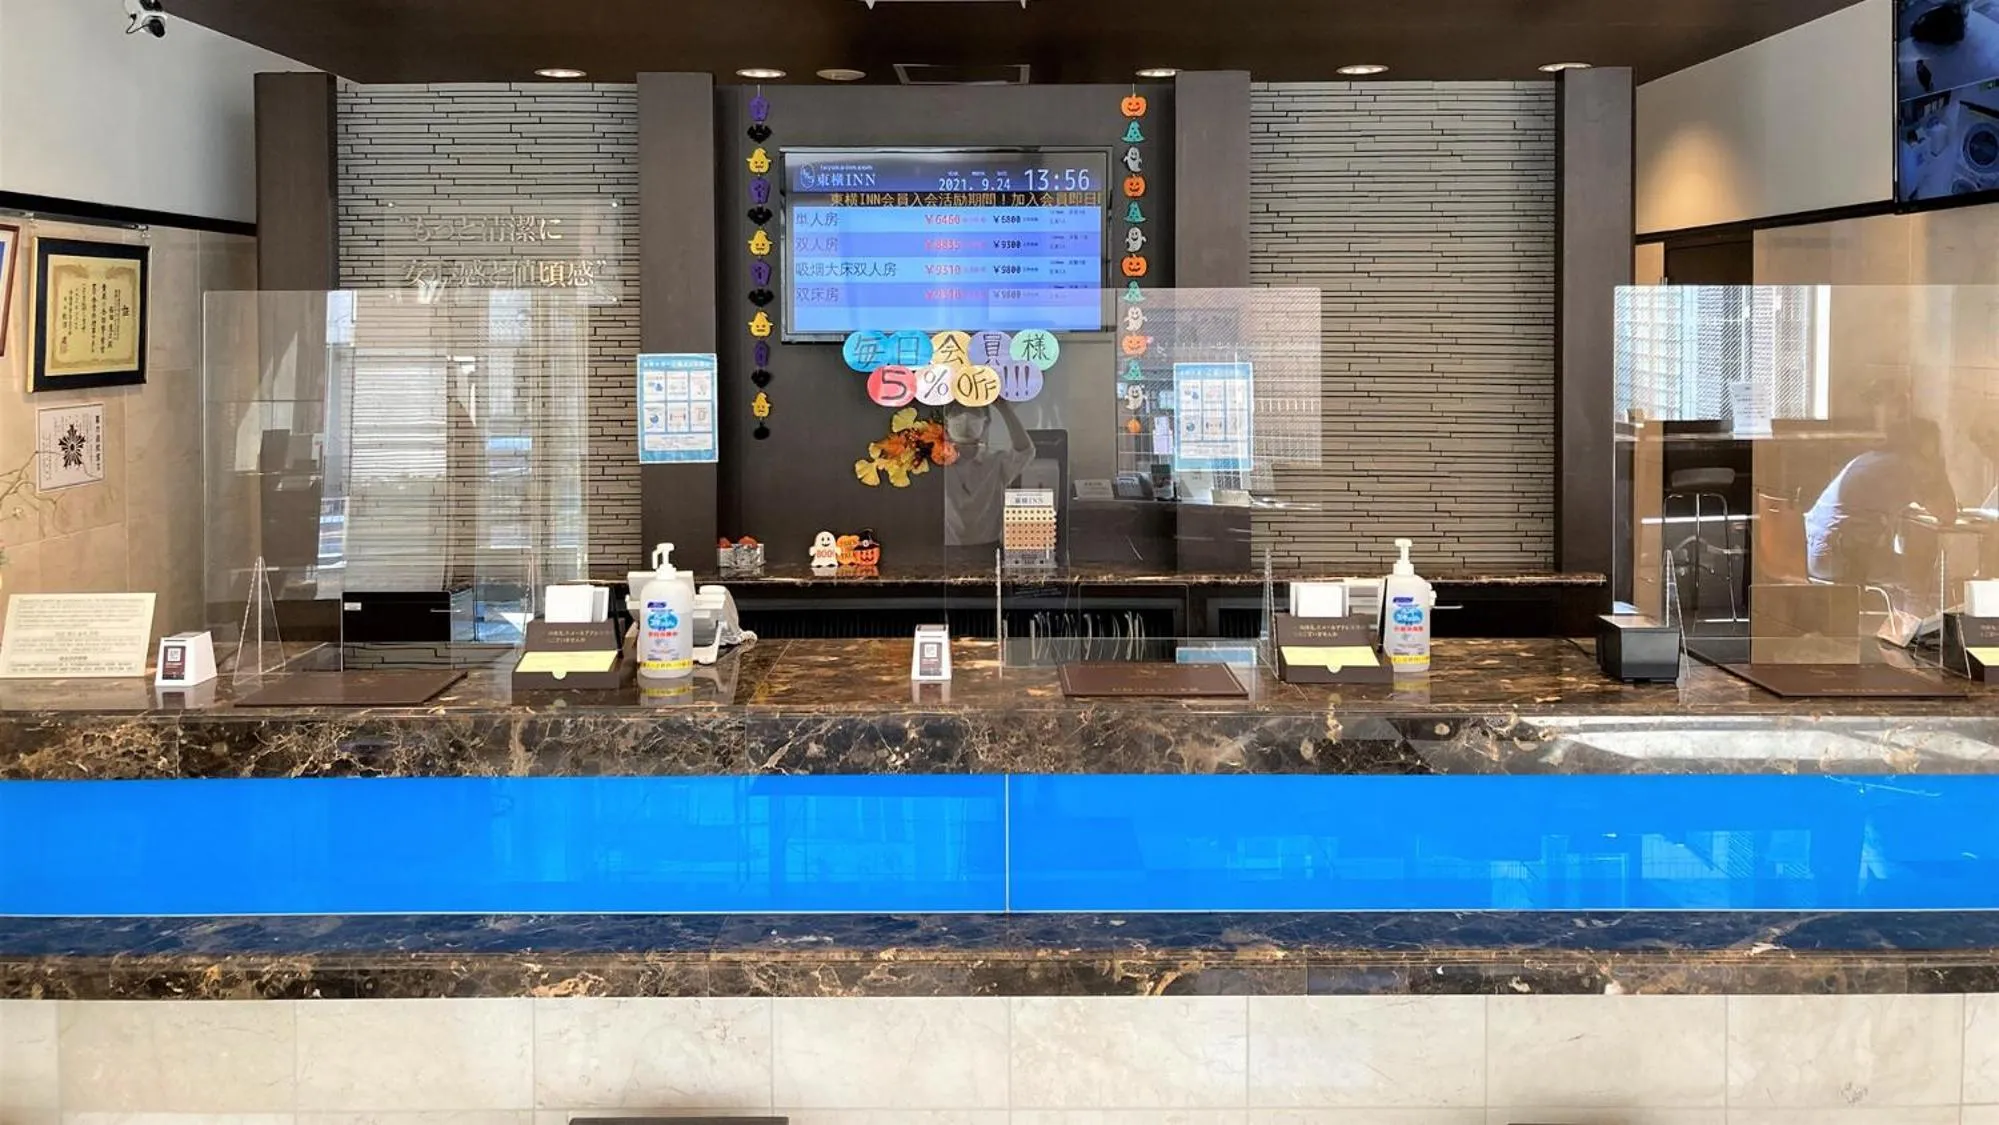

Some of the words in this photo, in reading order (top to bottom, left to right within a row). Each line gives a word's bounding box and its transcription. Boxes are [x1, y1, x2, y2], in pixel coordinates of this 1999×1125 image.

[982, 177, 1011, 192] 9.24
[1024, 169, 1090, 192] 13:56
[796, 237, 839, 252] 双人房
